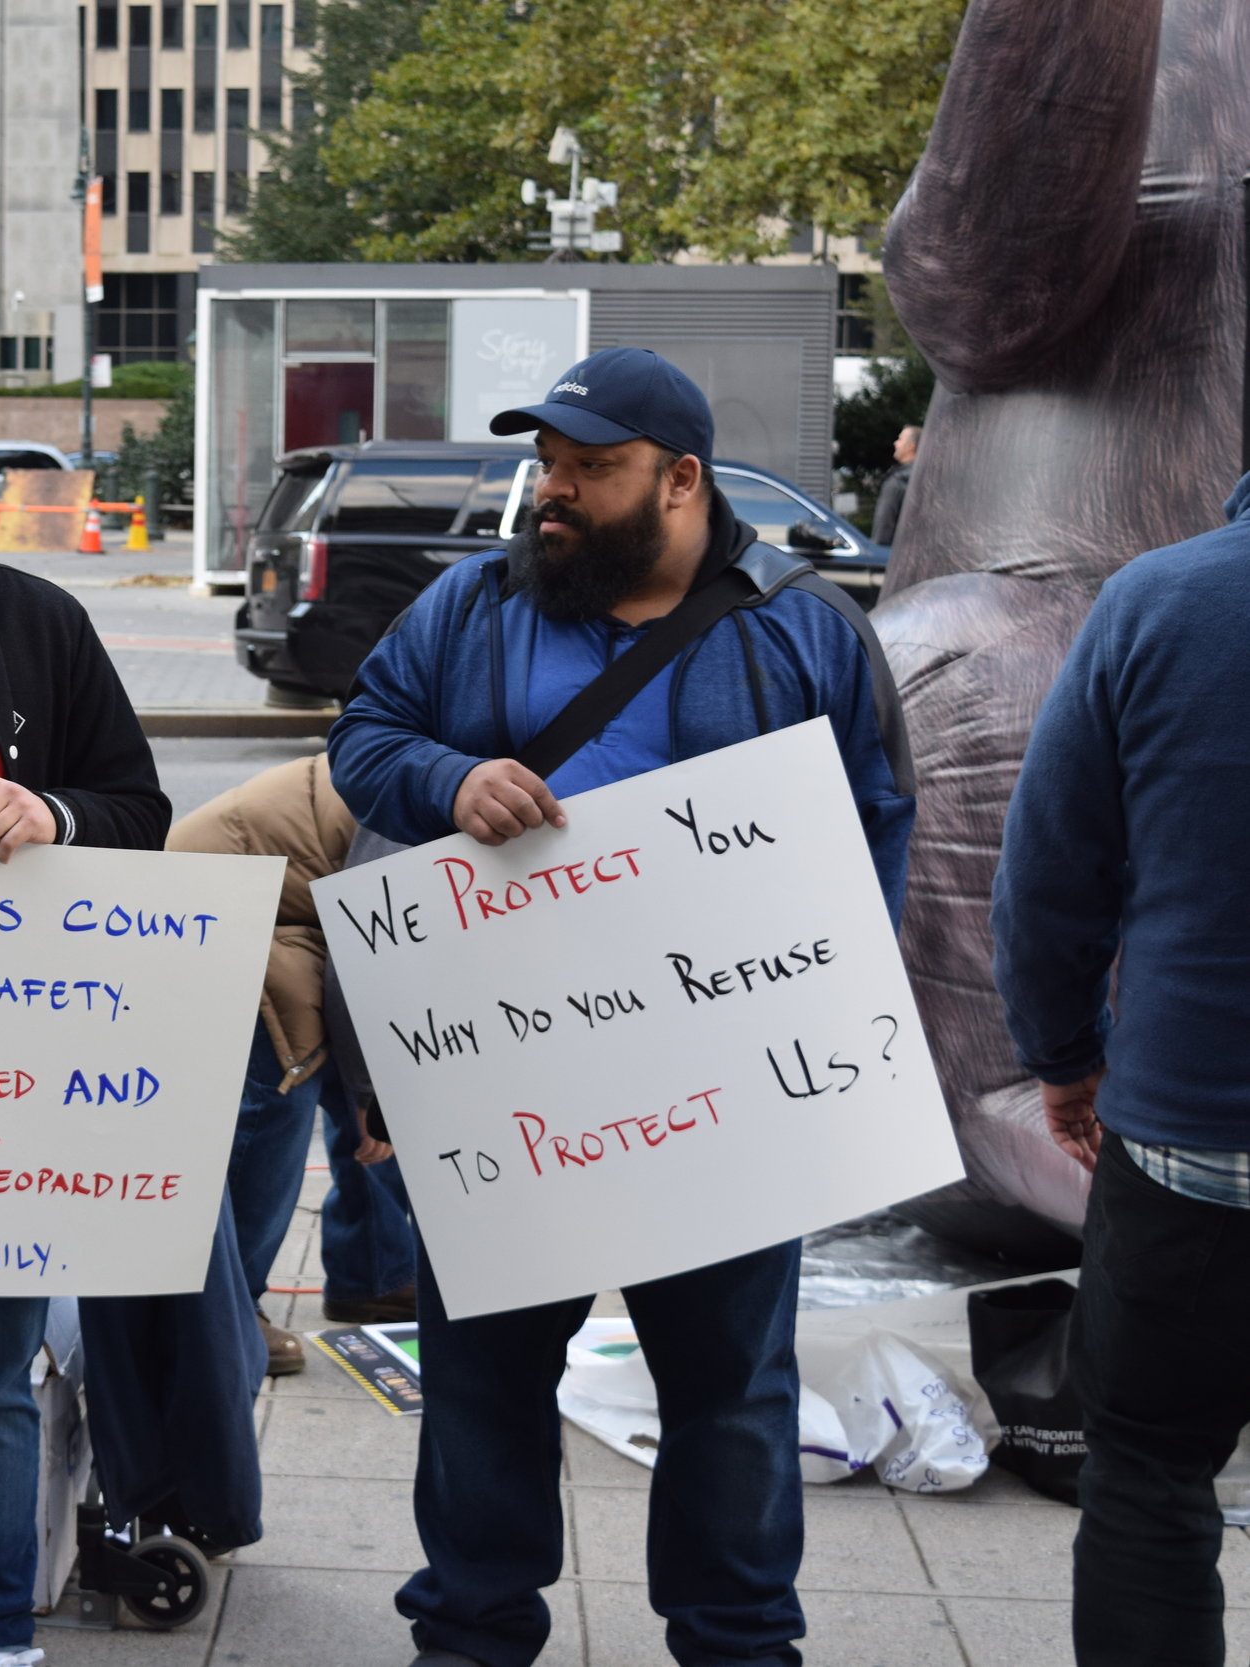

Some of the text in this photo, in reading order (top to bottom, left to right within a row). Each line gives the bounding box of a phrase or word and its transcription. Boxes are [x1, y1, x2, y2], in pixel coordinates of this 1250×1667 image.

[553, 381, 589, 396] adidas
[62, 899, 219, 946] COUNT
[337, 875, 428, 955] WE
[434, 856, 641, 930] PROTECT
[388, 1007, 480, 1066] WHY
[497, 999, 553, 1041] DO
[664, 938, 836, 1005] REFUSE
[62, 1066, 160, 1108] AND
[438, 1148, 500, 1195] TO
[511, 1087, 722, 1177] PROTECT
[1012, 1437, 1050, 1454] WITHUT
[1037, 1429, 1084, 1441] FRONTIE
